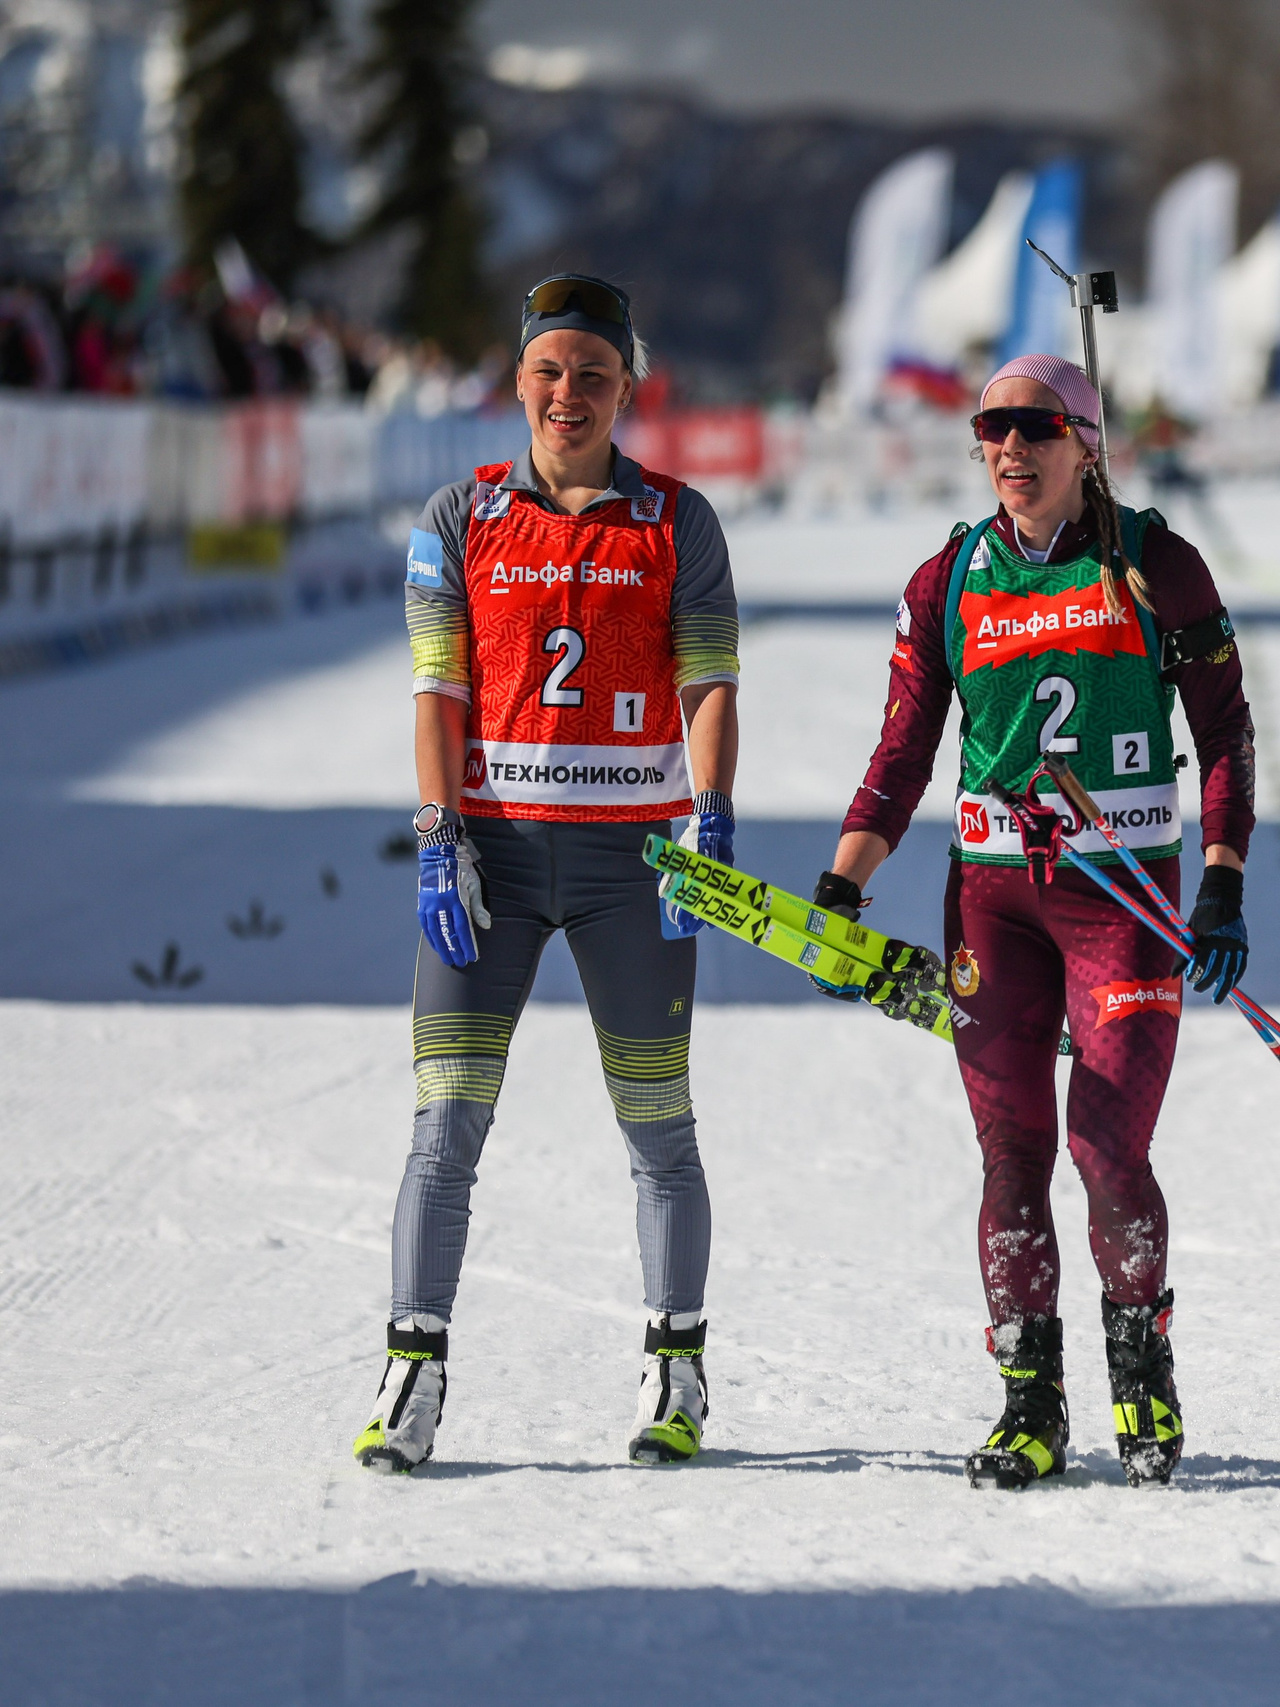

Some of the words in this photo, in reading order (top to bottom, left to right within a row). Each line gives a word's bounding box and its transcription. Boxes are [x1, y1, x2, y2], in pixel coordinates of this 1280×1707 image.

[490, 561, 574, 590] Альфа
[580, 562, 644, 588] Банк
[977, 610, 1060, 640] Альфа
[1065, 604, 1129, 629] Банк
[539, 625, 586, 708] 2
[626, 698, 636, 727] 1
[1033, 673, 1082, 755] 2
[1123, 740, 1140, 769] 2
[490, 763, 666, 785] ТЕХНОНИКОЛЬ
[993, 805, 1173, 833] ТЕОКОЛЬ
[655, 844, 744, 898] FISCHER
[673, 880, 751, 931] FISCHER
[1106, 988, 1156, 1010] Альфа
[1156, 987, 1179, 1002] Банк
